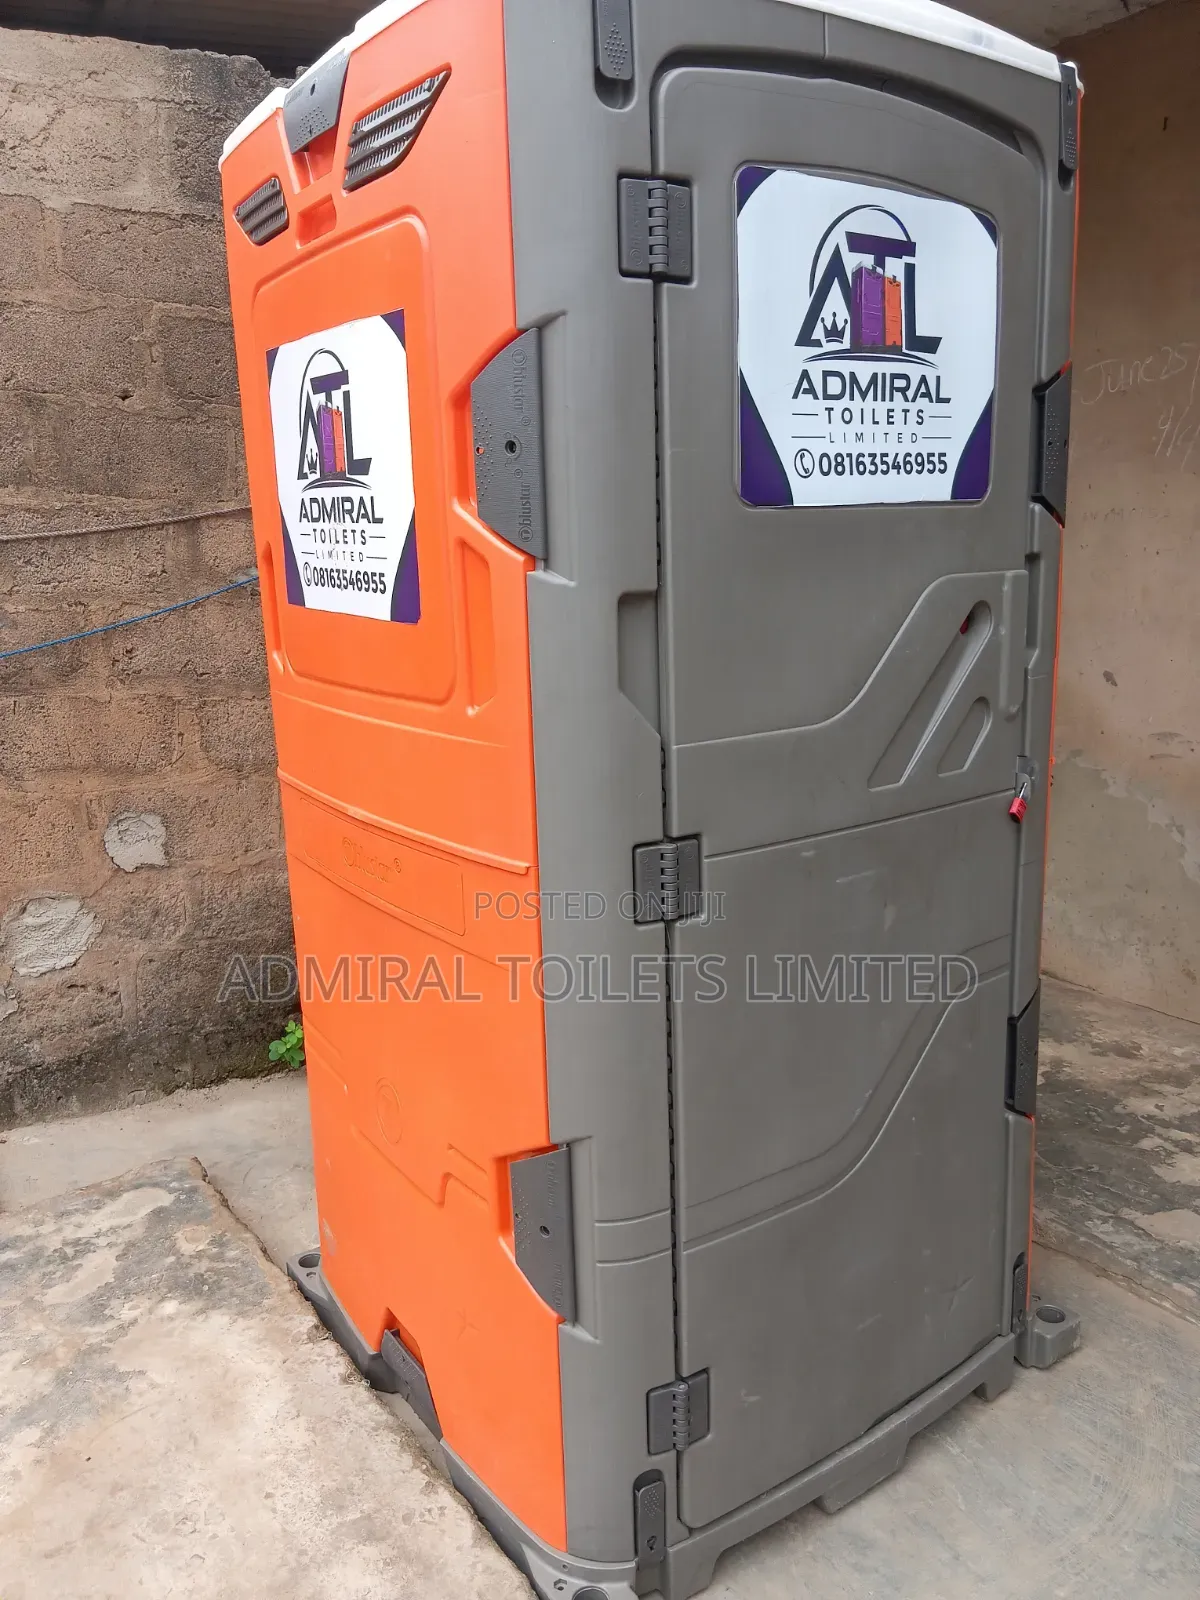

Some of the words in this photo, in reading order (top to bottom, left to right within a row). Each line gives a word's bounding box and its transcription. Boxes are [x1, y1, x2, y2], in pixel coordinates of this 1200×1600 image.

[791, 368, 952, 404] ADMIRAL
[824, 407, 925, 426] TOILETS
[829, 432, 919, 444] LIMITED
[818, 452, 948, 477] 08163546955
[298, 495, 384, 525] ADMIRAL
[312, 528, 367, 546] TOILETS
[315, 549, 364, 563] LIMITED
[312, 566, 387, 595] 08163546955
